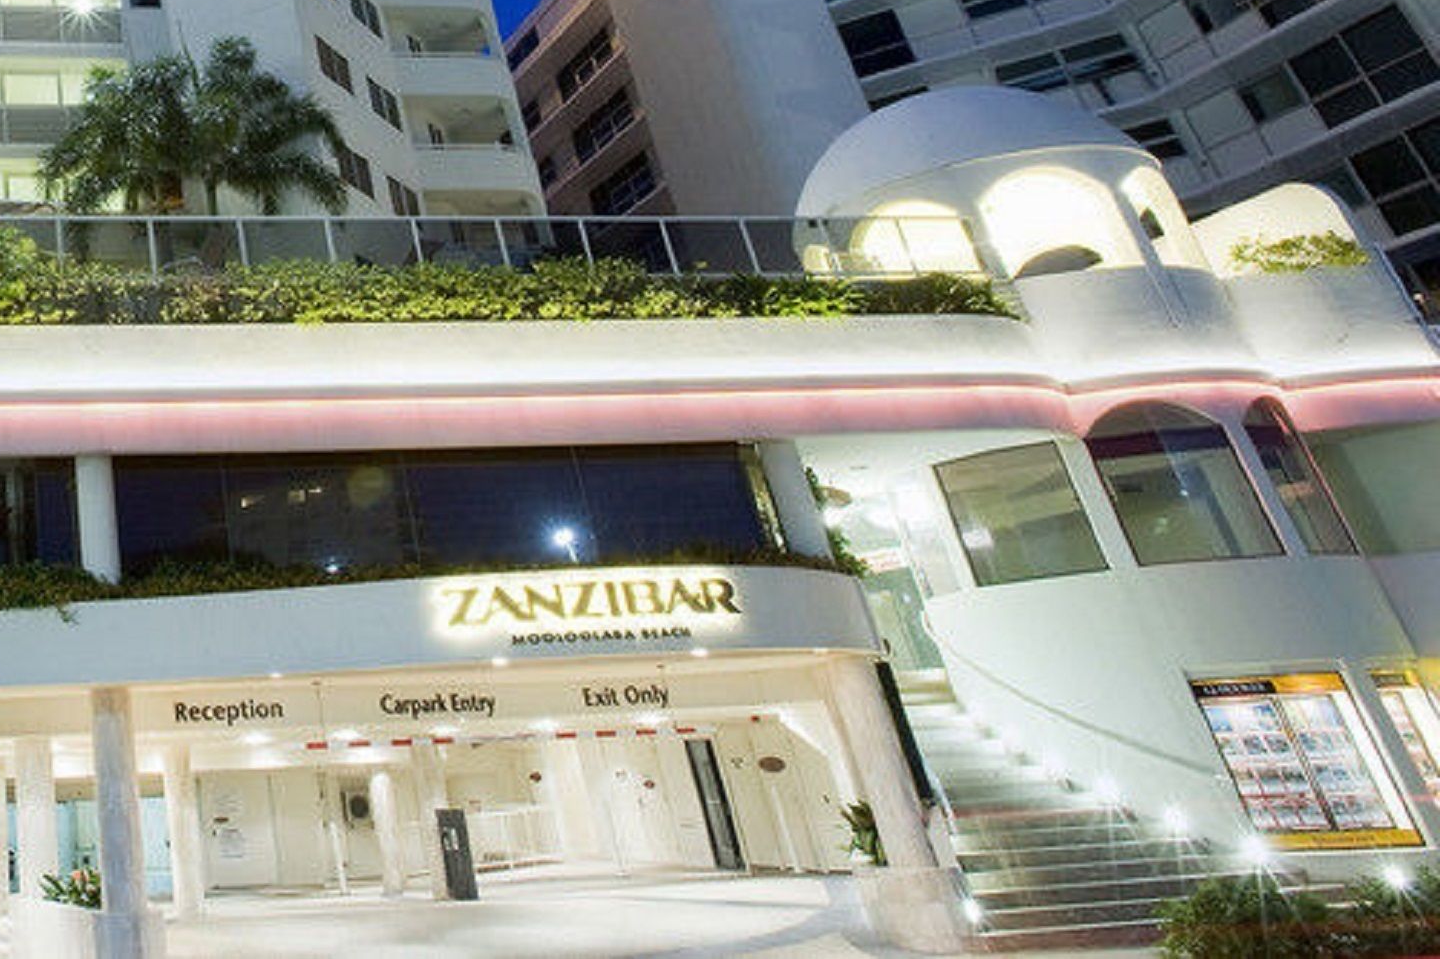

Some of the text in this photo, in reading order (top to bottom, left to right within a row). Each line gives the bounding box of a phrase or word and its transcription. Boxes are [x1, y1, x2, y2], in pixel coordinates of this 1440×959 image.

[442, 577, 742, 627] ZANZIBAR
[640, 626, 692, 640] BEACH
[380, 693, 496, 718] Carpark Entry
[582, 684, 669, 708] Exit Only
[174, 699, 284, 725] Reception
